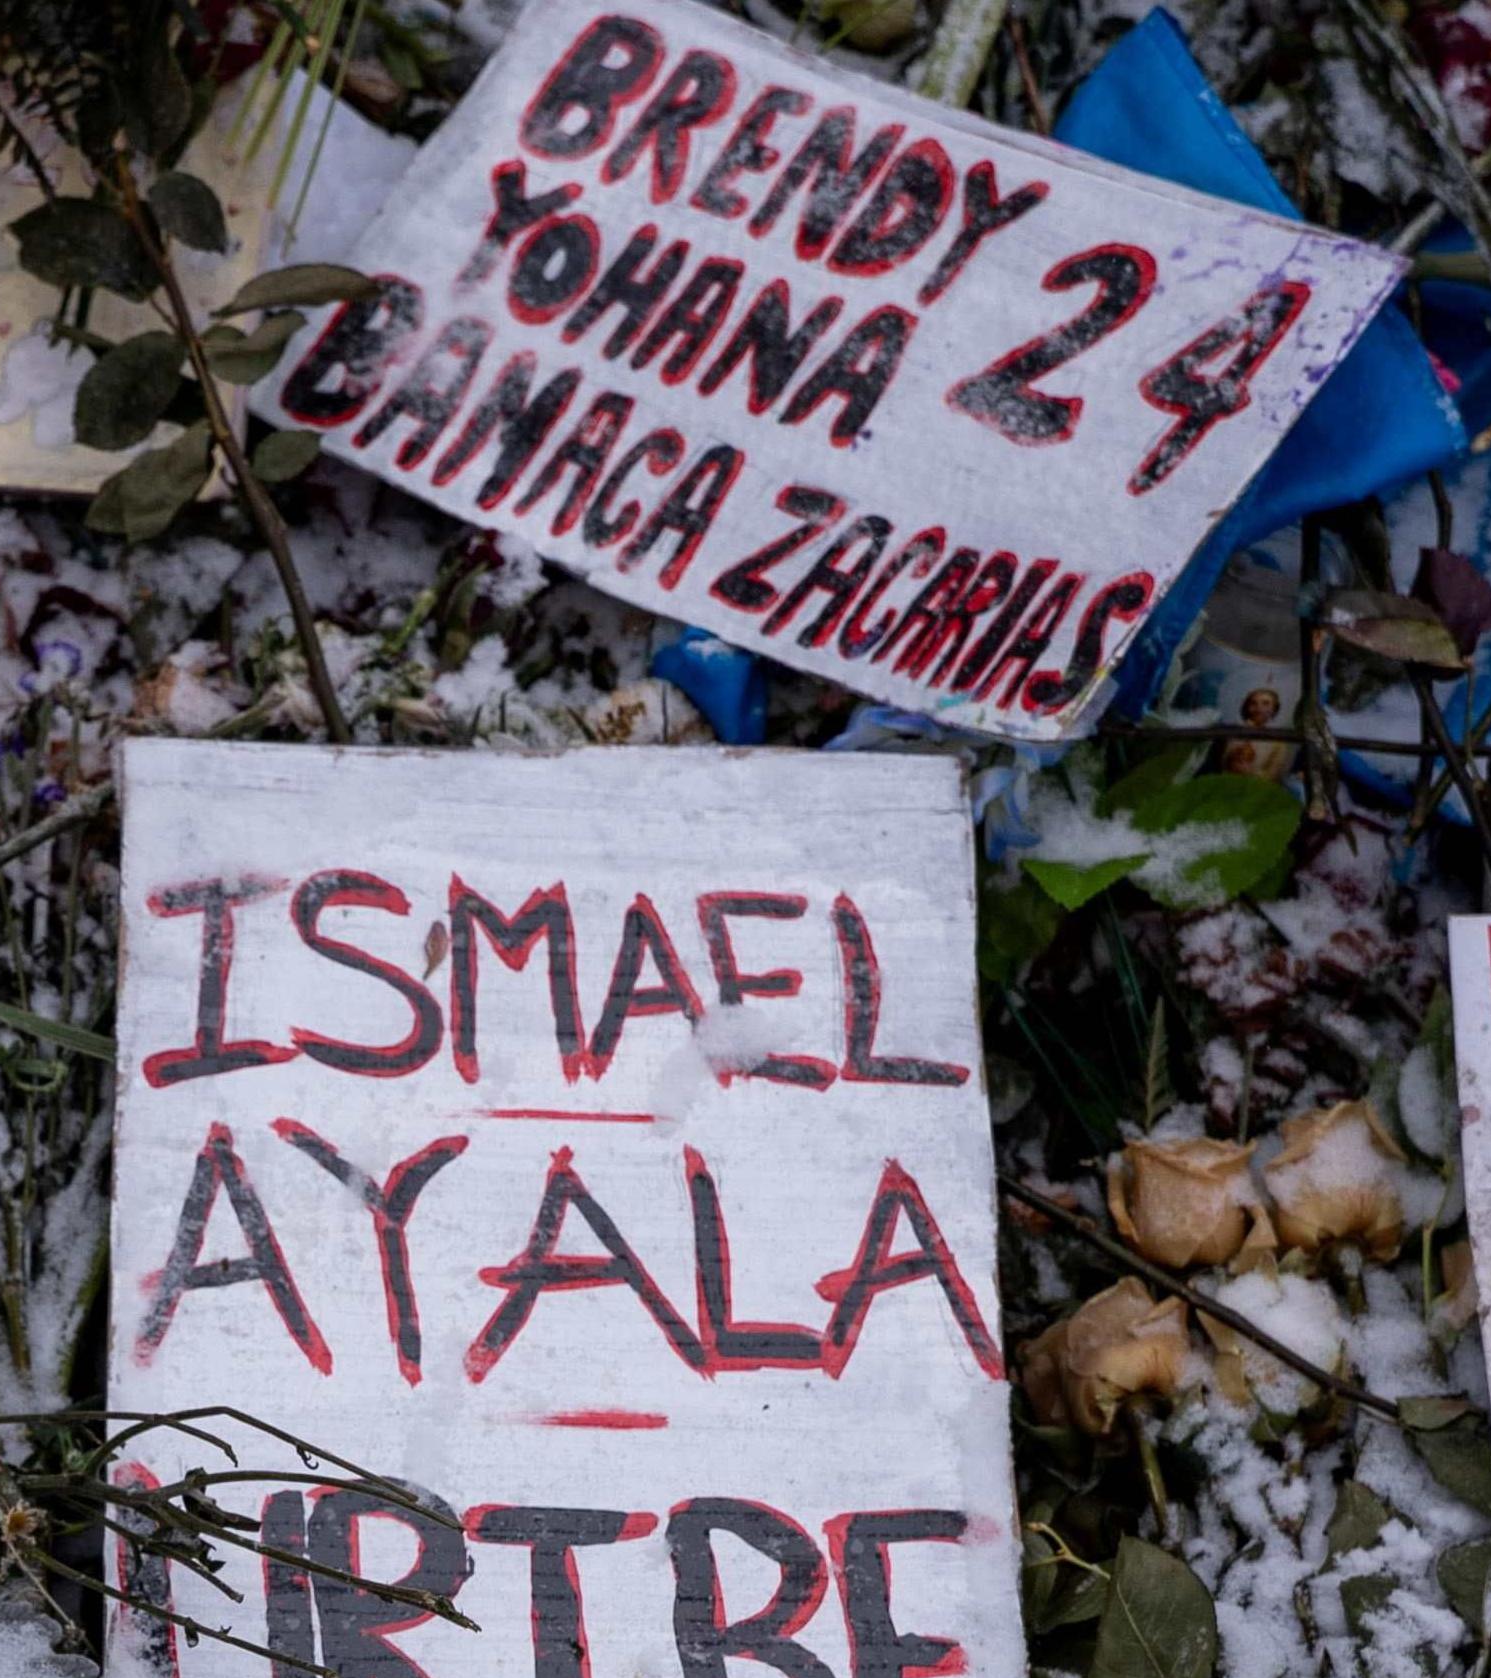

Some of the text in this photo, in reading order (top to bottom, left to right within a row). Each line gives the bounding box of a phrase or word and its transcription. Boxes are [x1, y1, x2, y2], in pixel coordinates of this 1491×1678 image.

[521, 13, 1050, 306] BRENDY
[456, 161, 920, 448] YOHANA
[944, 243, 1312, 497] 24
[280, 273, 1155, 717] BAMACA ZACARIAS
[142, 869, 971, 1092] ISMAEL
[134, 1117, 1004, 1386] AYALA
